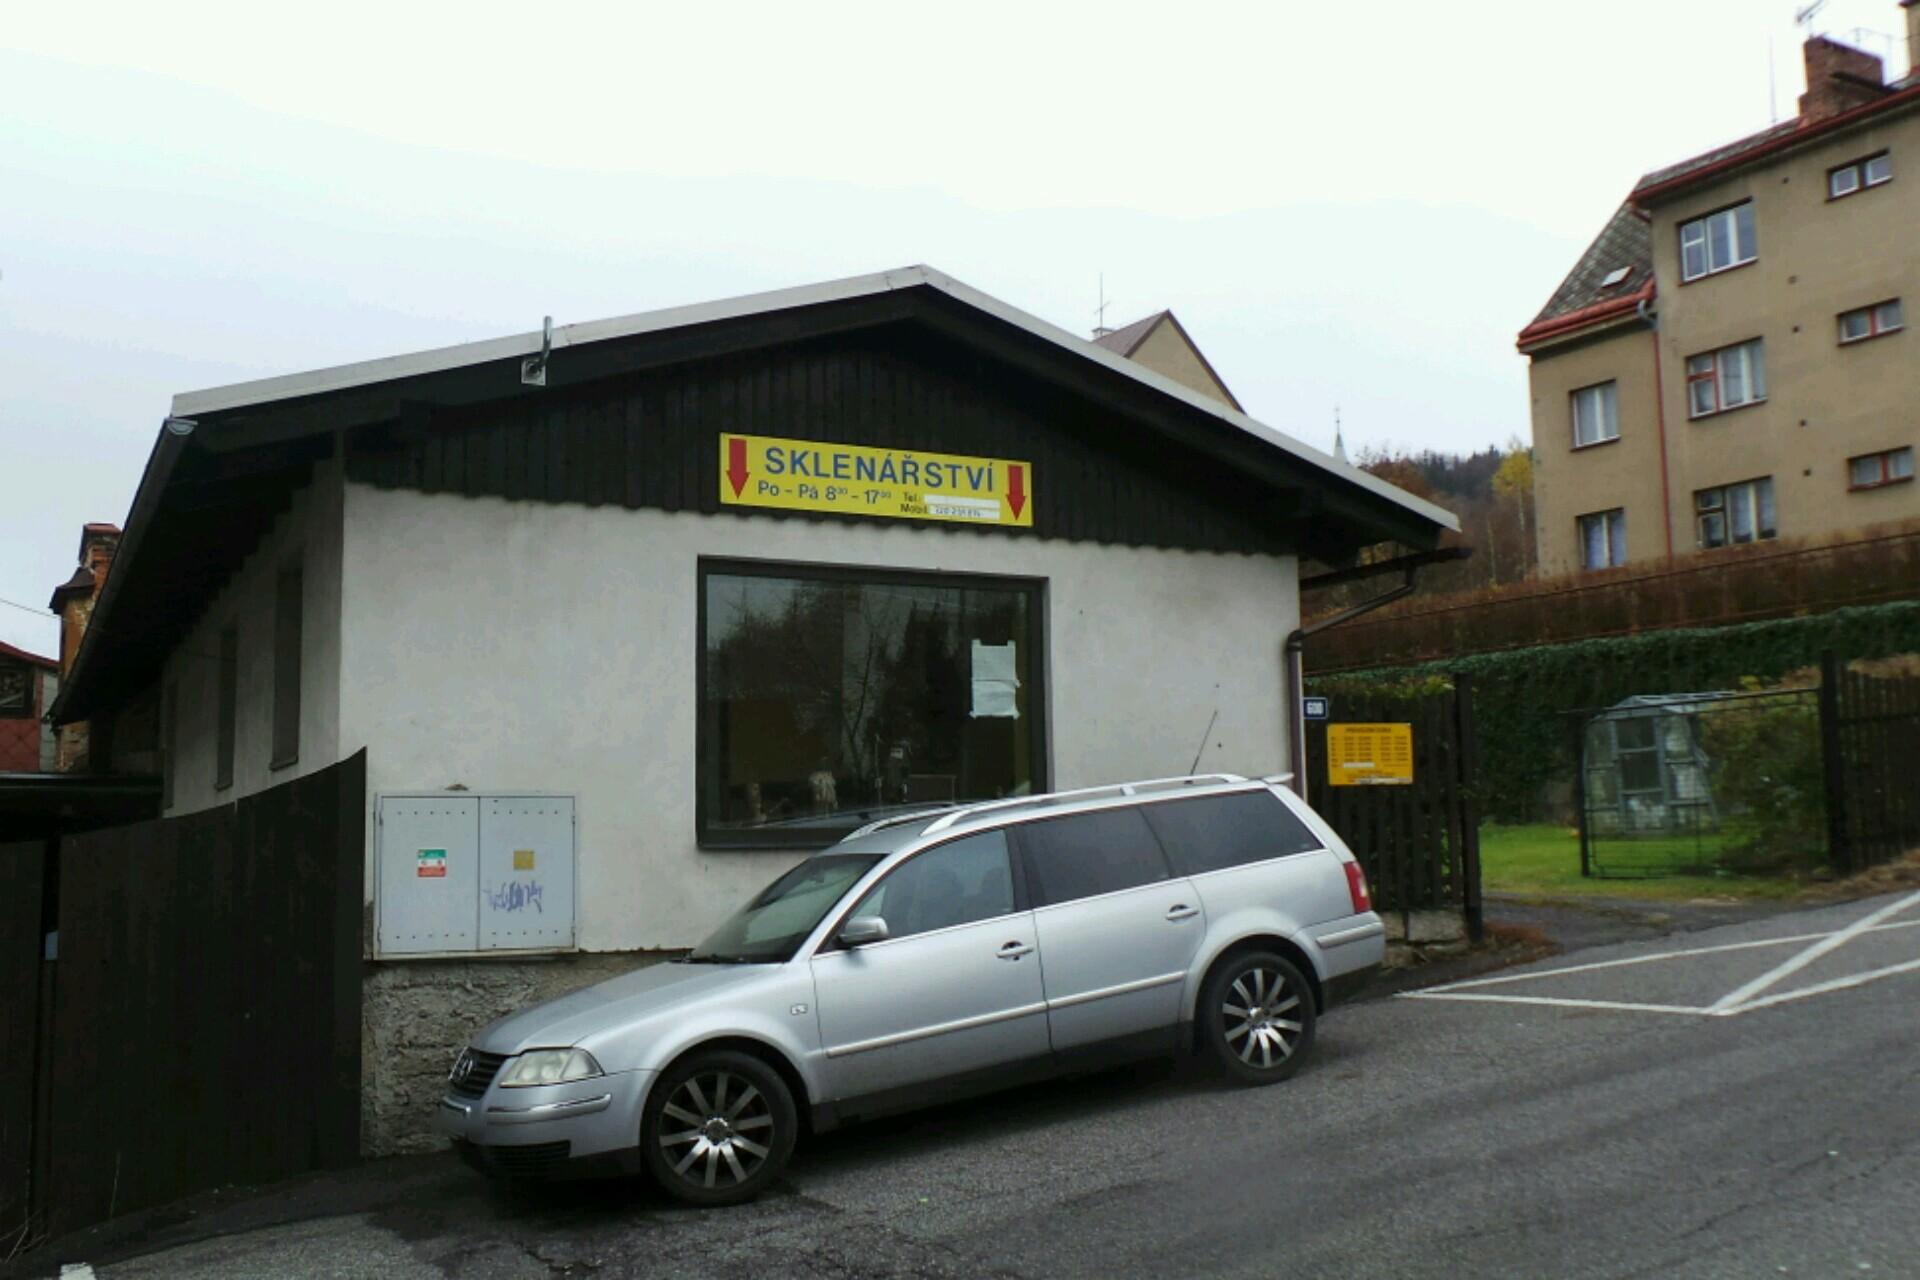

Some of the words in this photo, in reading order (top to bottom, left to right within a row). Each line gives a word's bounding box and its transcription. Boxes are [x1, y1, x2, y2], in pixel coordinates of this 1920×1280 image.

[765, 446, 993, 492] SKLENÁŘSTVÍ
[758, 480, 779, 496] Po
[798, 483, 818, 500] Pá
